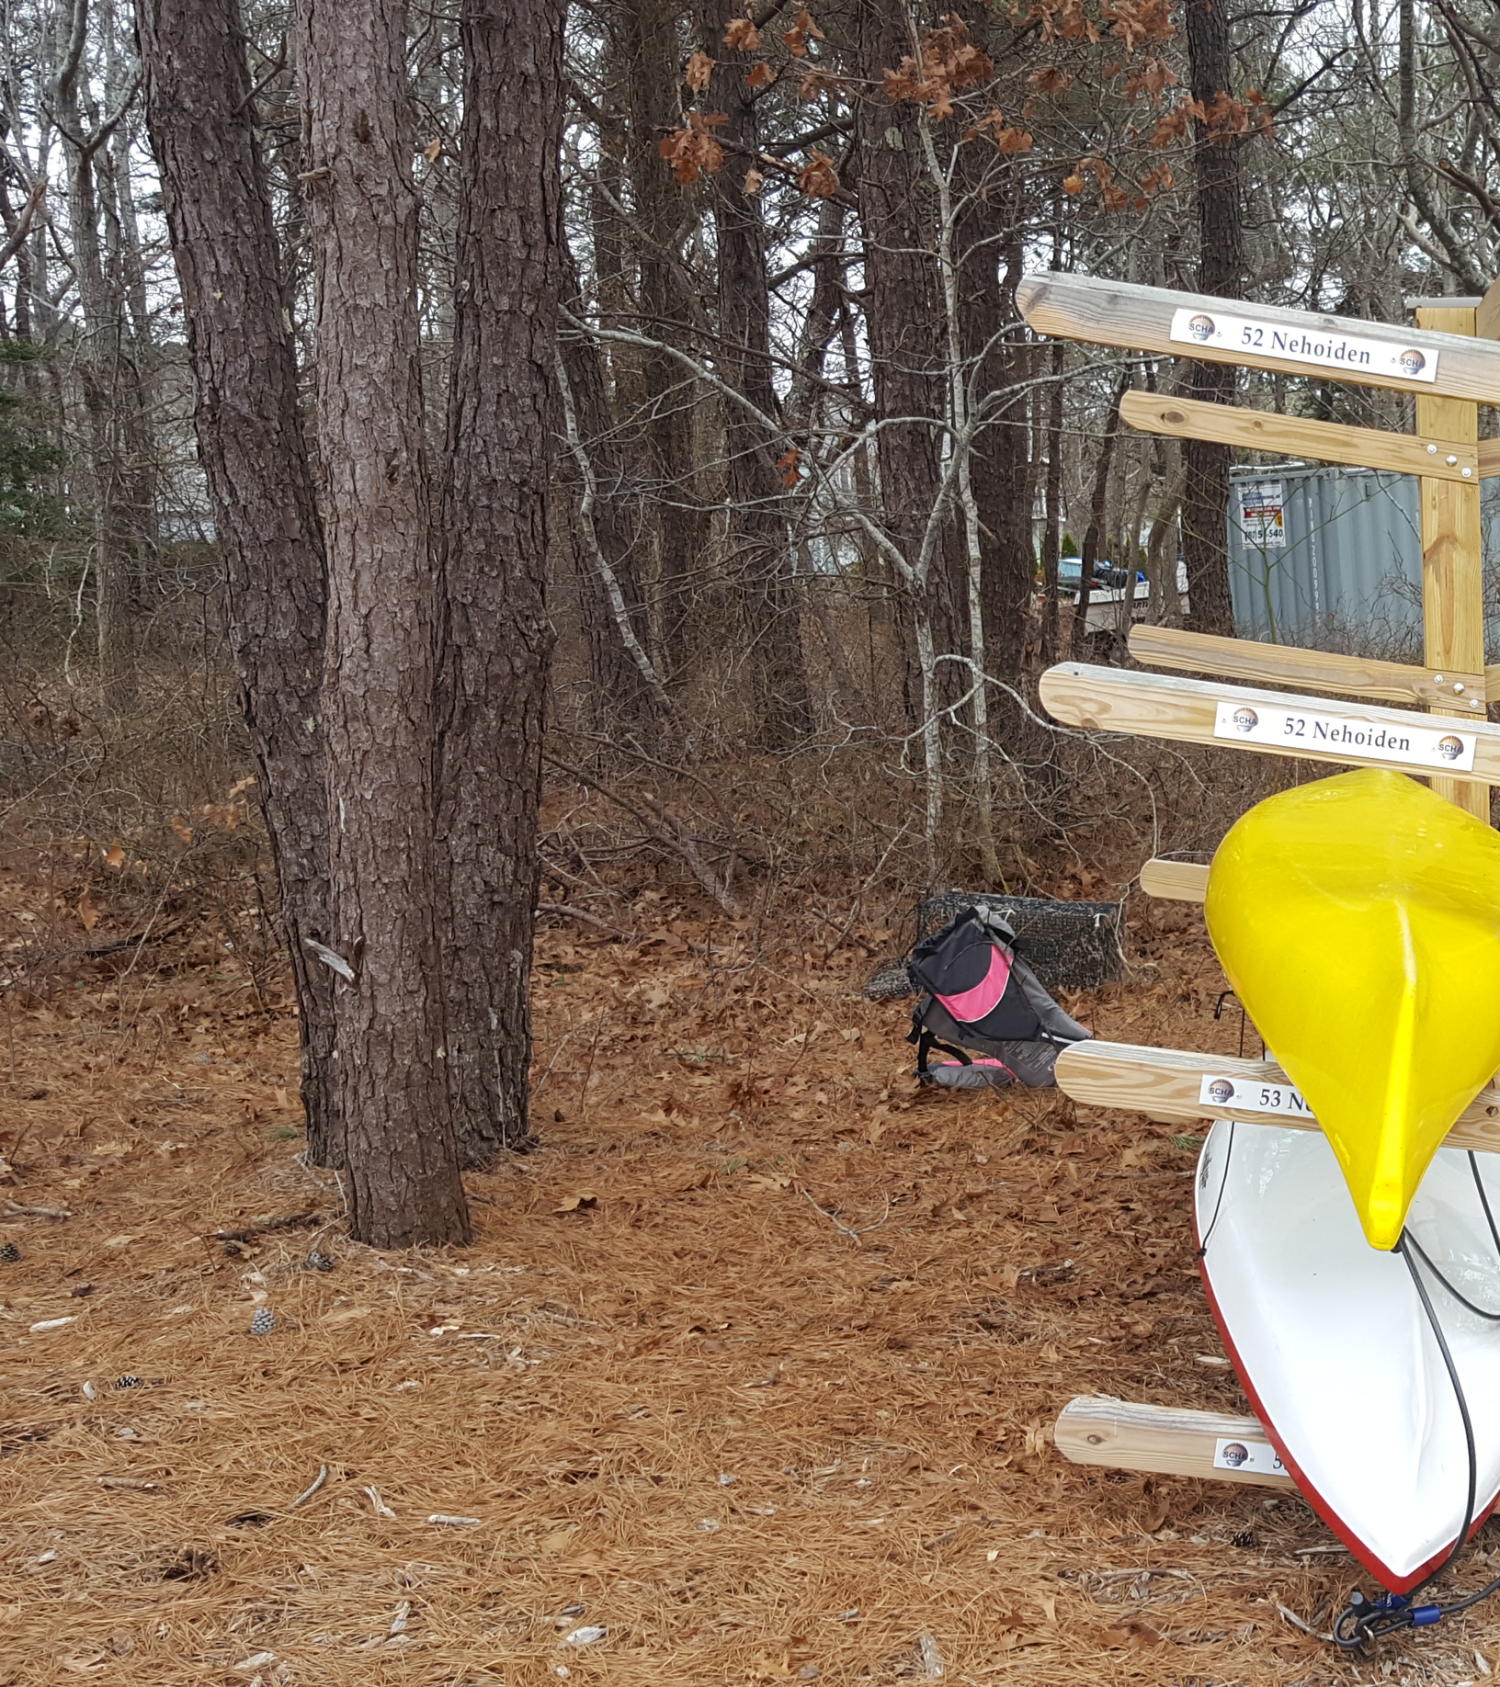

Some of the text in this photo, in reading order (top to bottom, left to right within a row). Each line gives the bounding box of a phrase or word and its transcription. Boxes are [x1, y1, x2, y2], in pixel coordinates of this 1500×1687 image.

[1241, 326, 1264, 347] 52
[1271, 331, 1371, 364] Nehoiden
[1283, 717, 1306, 737] 52
[1312, 721, 1410, 751] Nehoiden
[1259, 1088, 1281, 1107] 53
